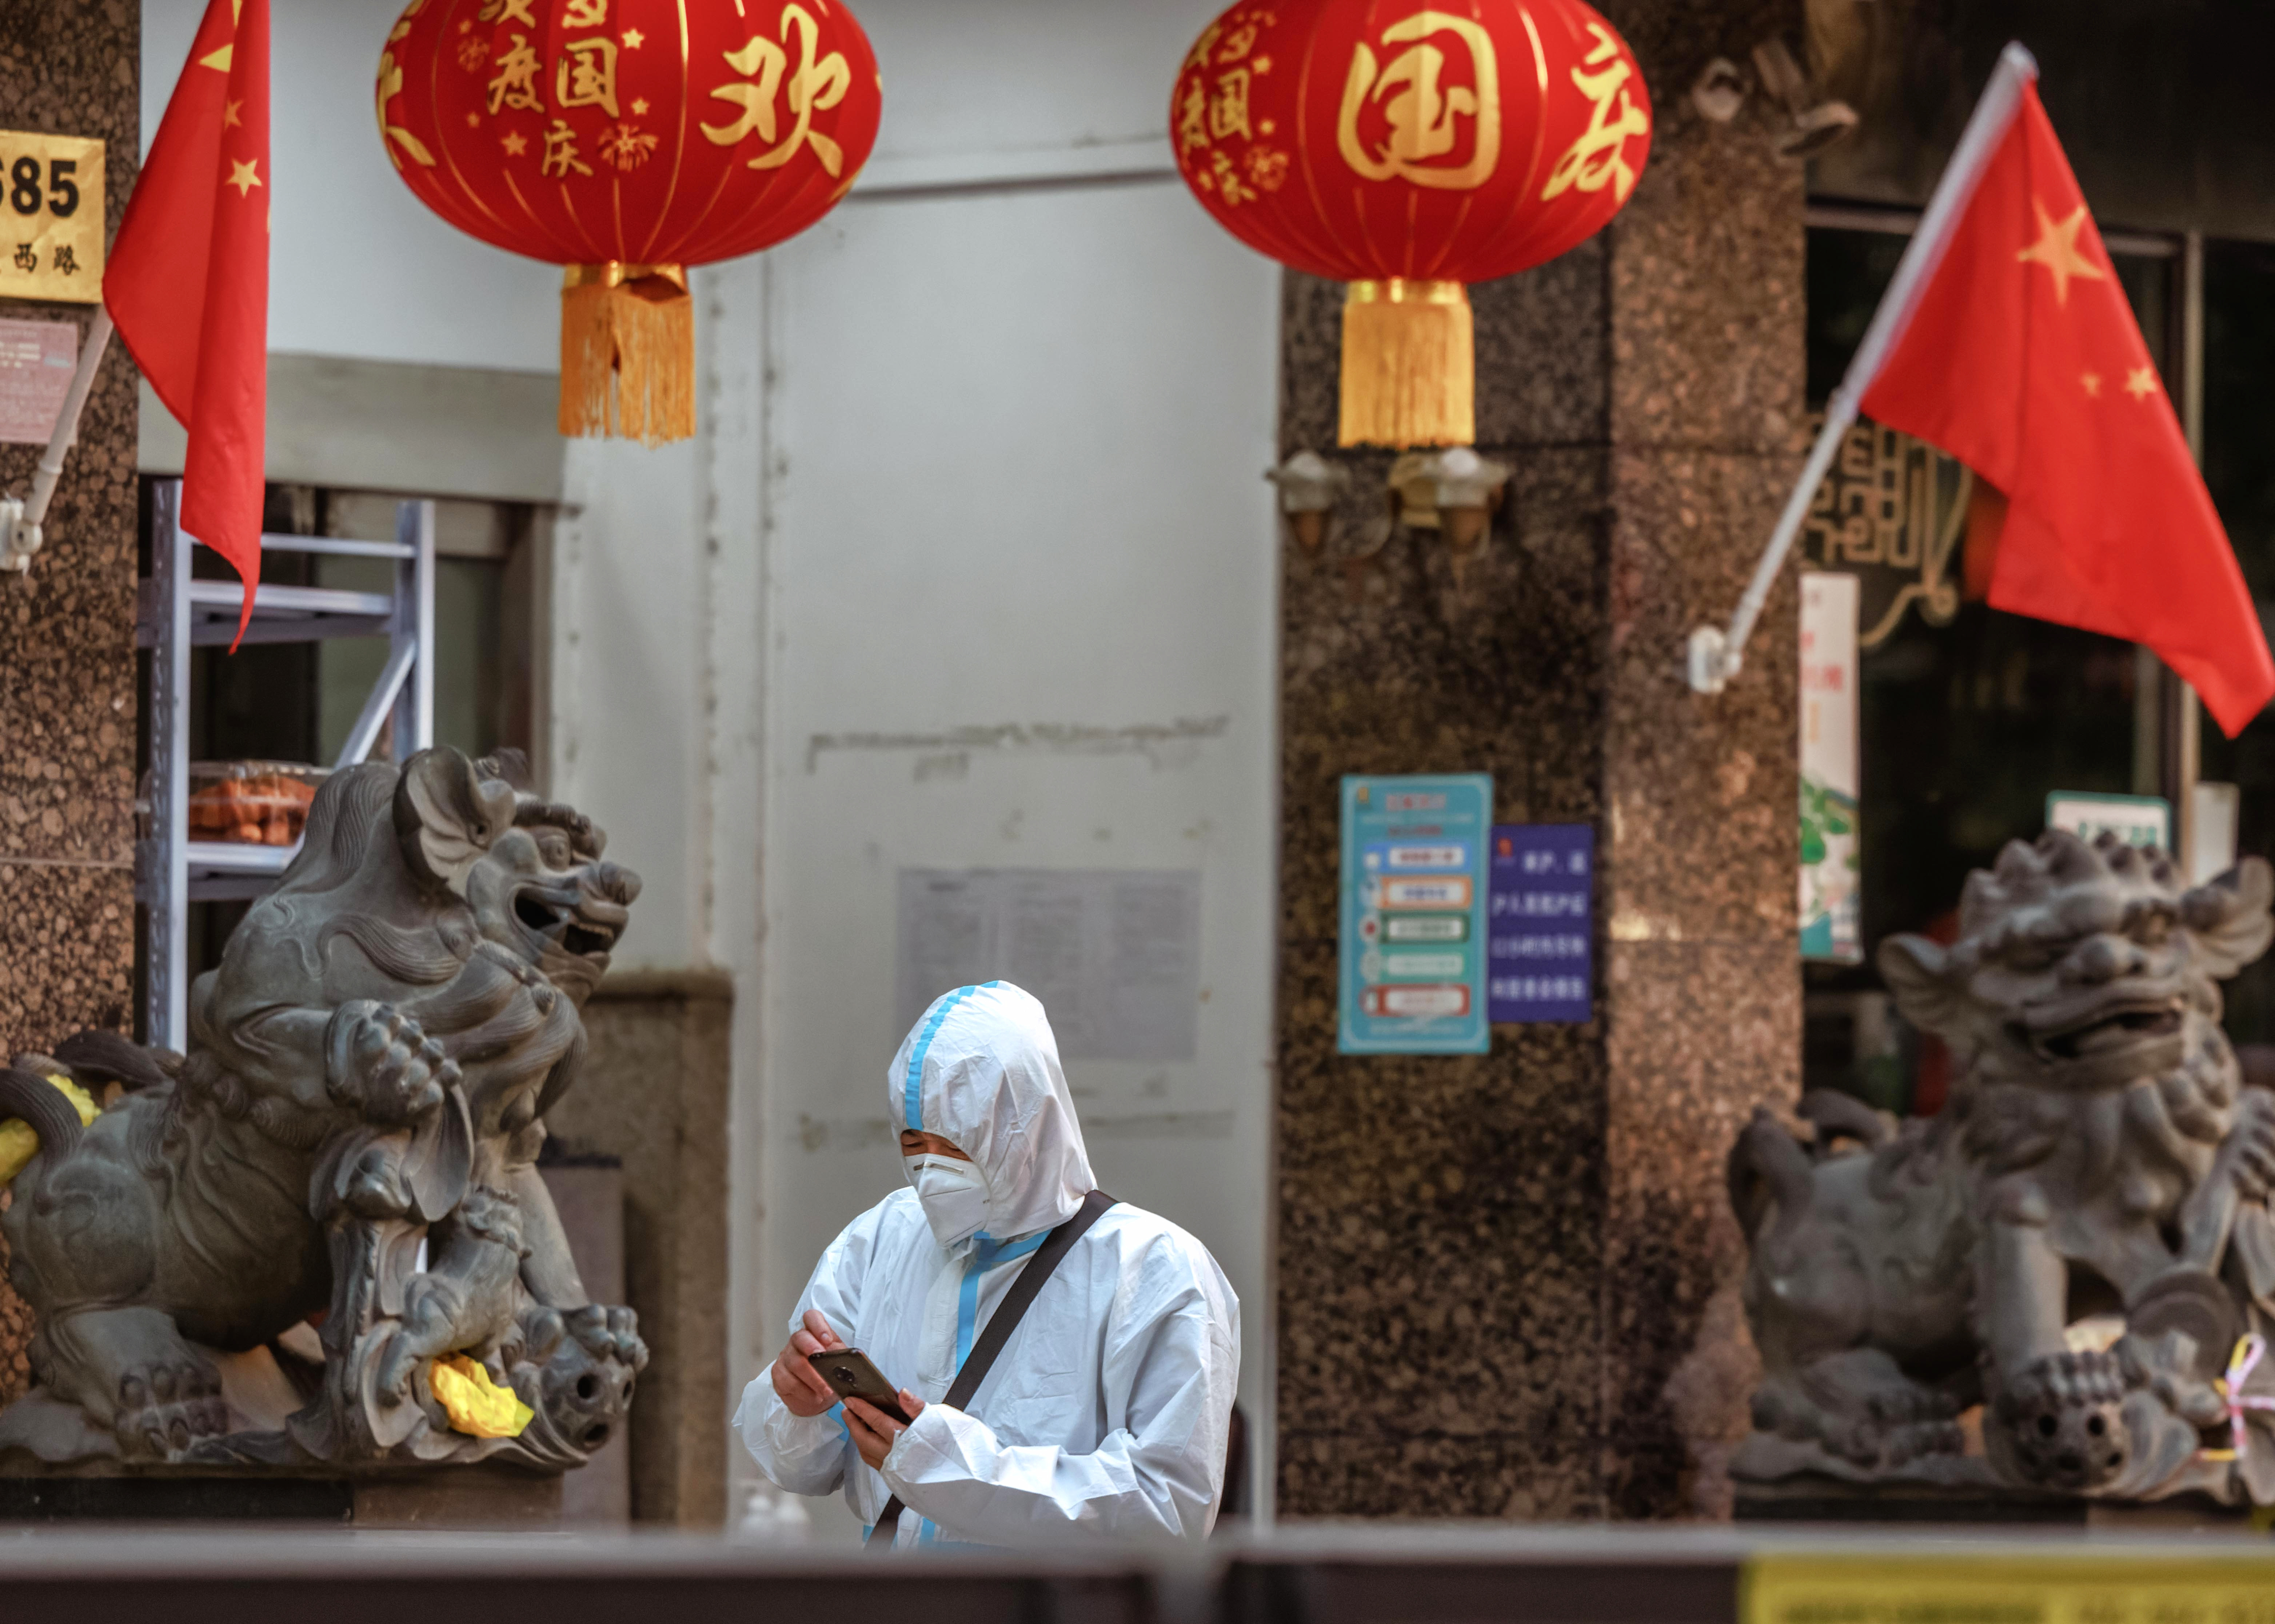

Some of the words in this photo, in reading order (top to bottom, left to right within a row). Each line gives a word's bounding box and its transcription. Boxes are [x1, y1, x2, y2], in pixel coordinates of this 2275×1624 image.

[699, 3, 851, 179] 欢
[0, 156, 79, 217] 85
[13, 243, 81, 276] 西路
